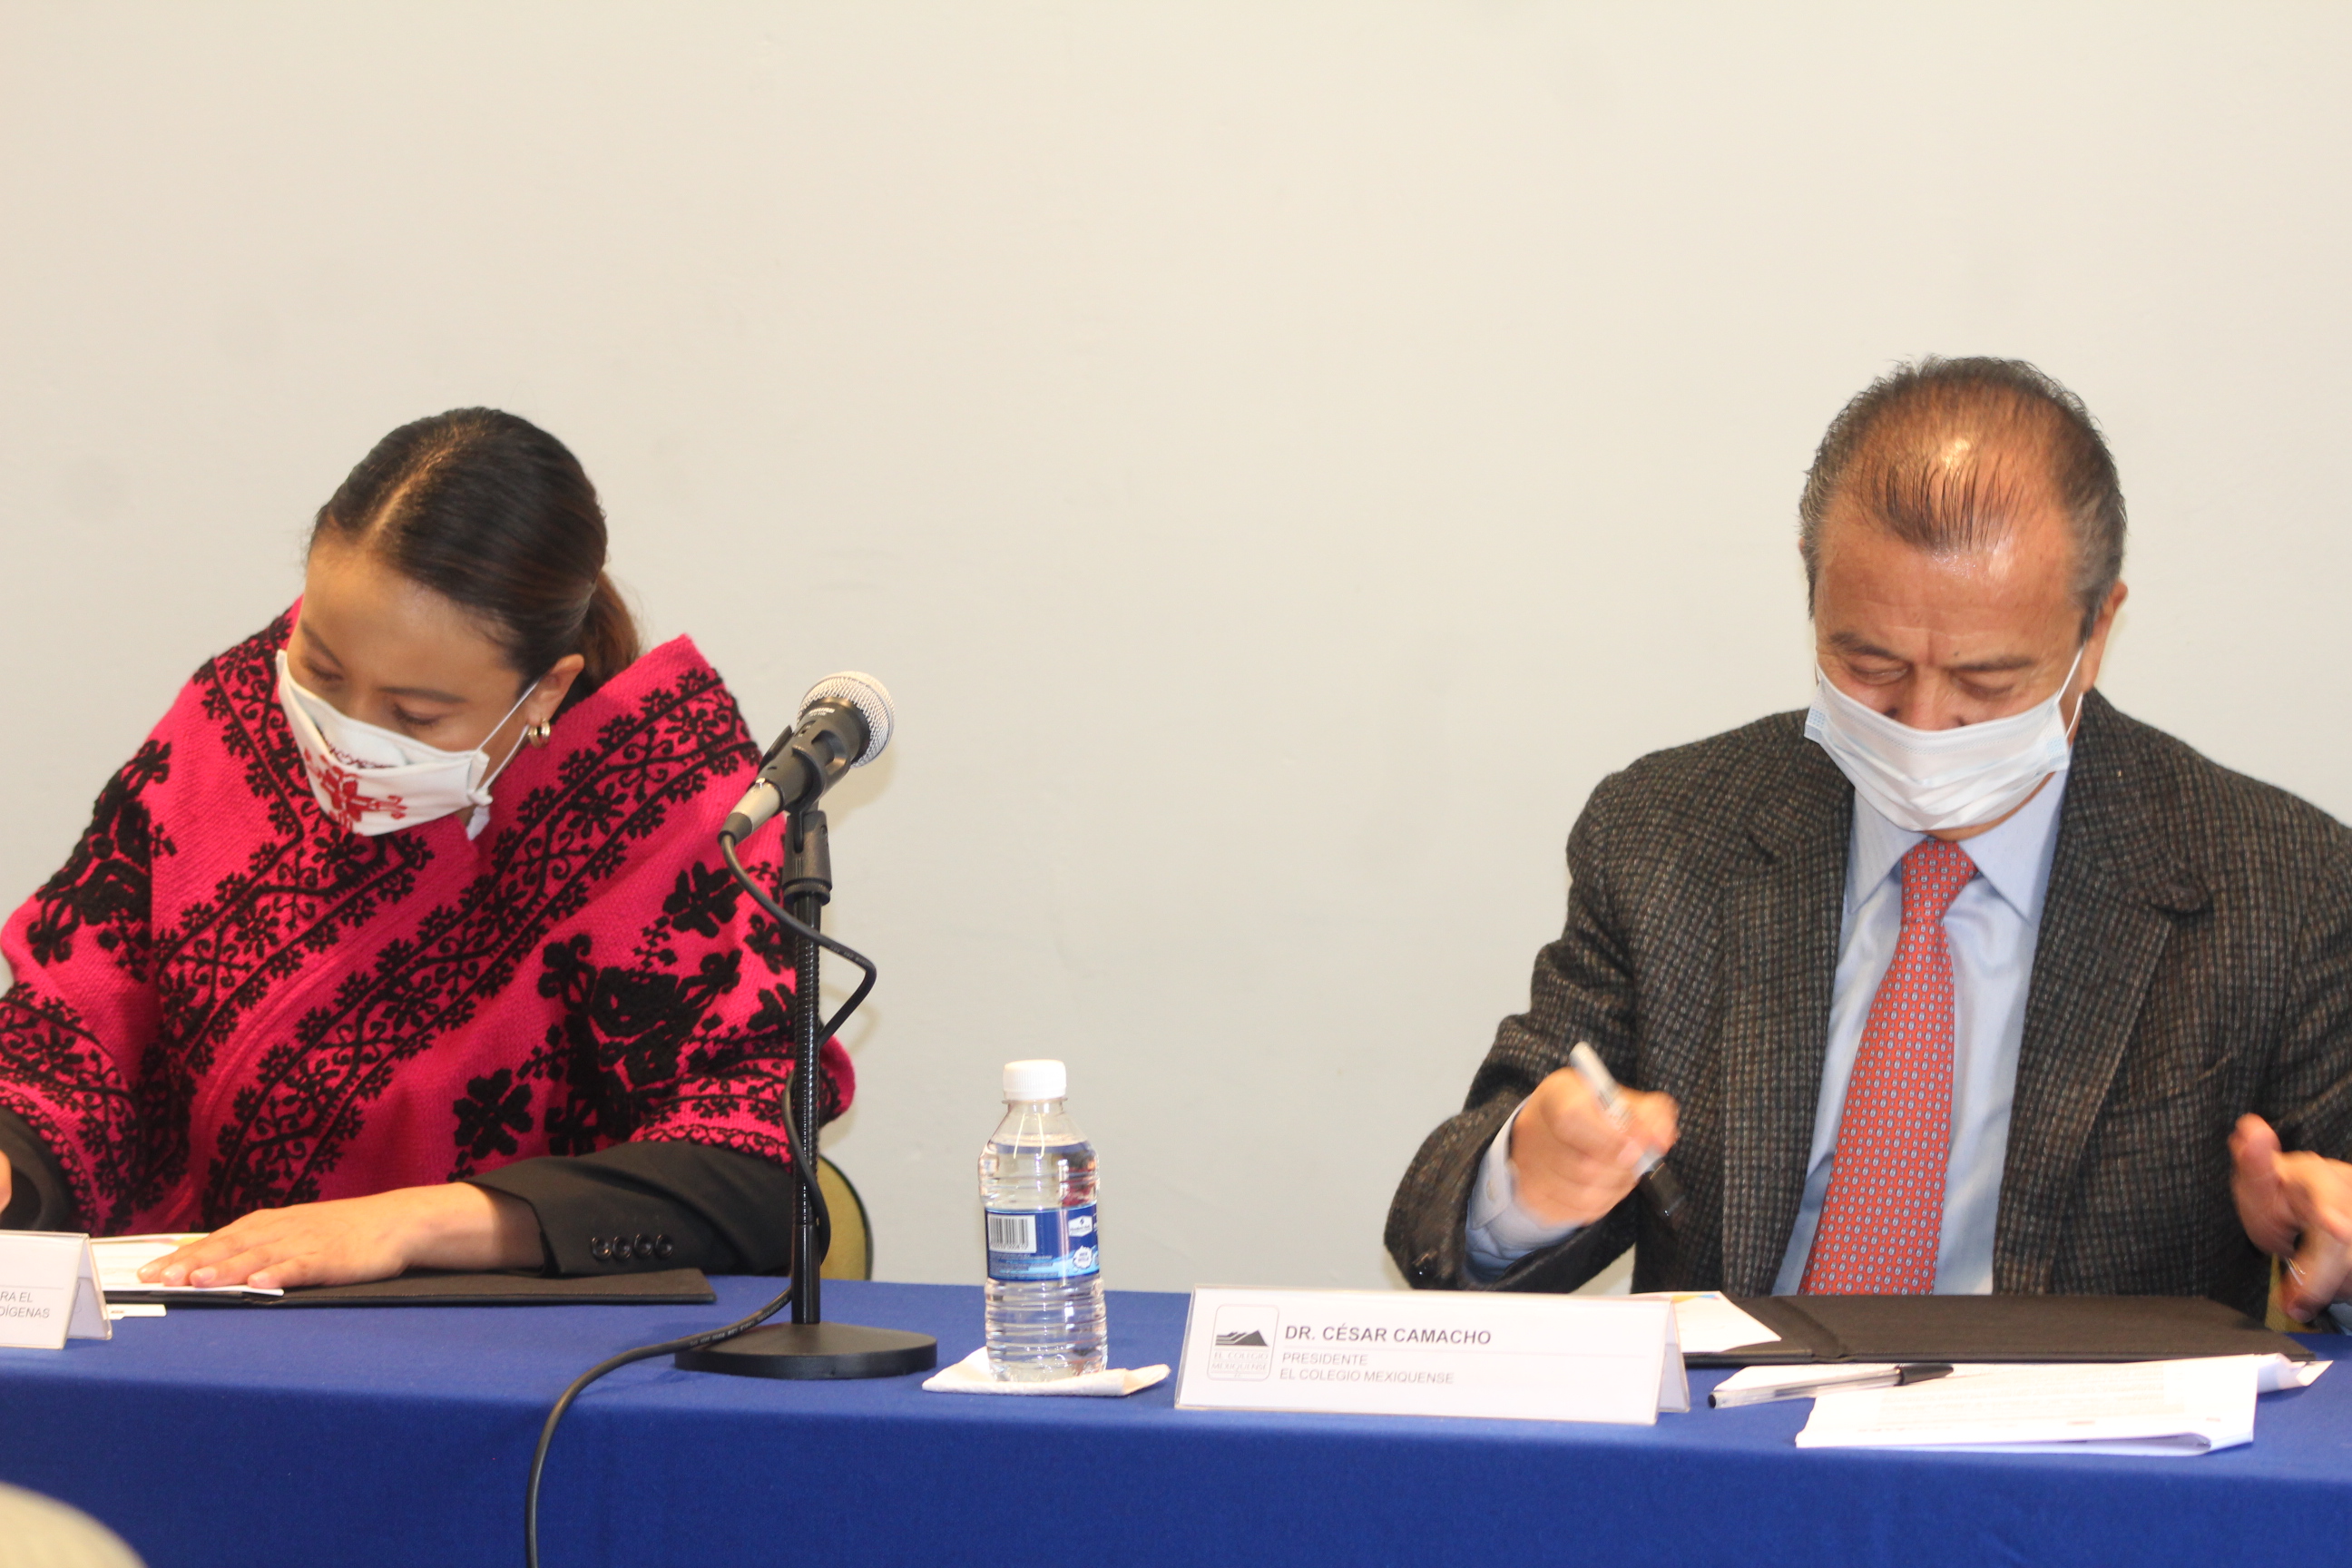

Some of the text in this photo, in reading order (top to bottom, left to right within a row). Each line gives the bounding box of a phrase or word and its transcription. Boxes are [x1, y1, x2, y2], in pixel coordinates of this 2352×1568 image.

[19, 1291, 34, 1303] EL
[1285, 1322, 1491, 1345] DR. CÉSAR CAMACHO
[1282, 1352, 1368, 1366] PRESIDENTE
[1279, 1368, 1455, 1385] EL COLEGIO MEXIQUENSE
